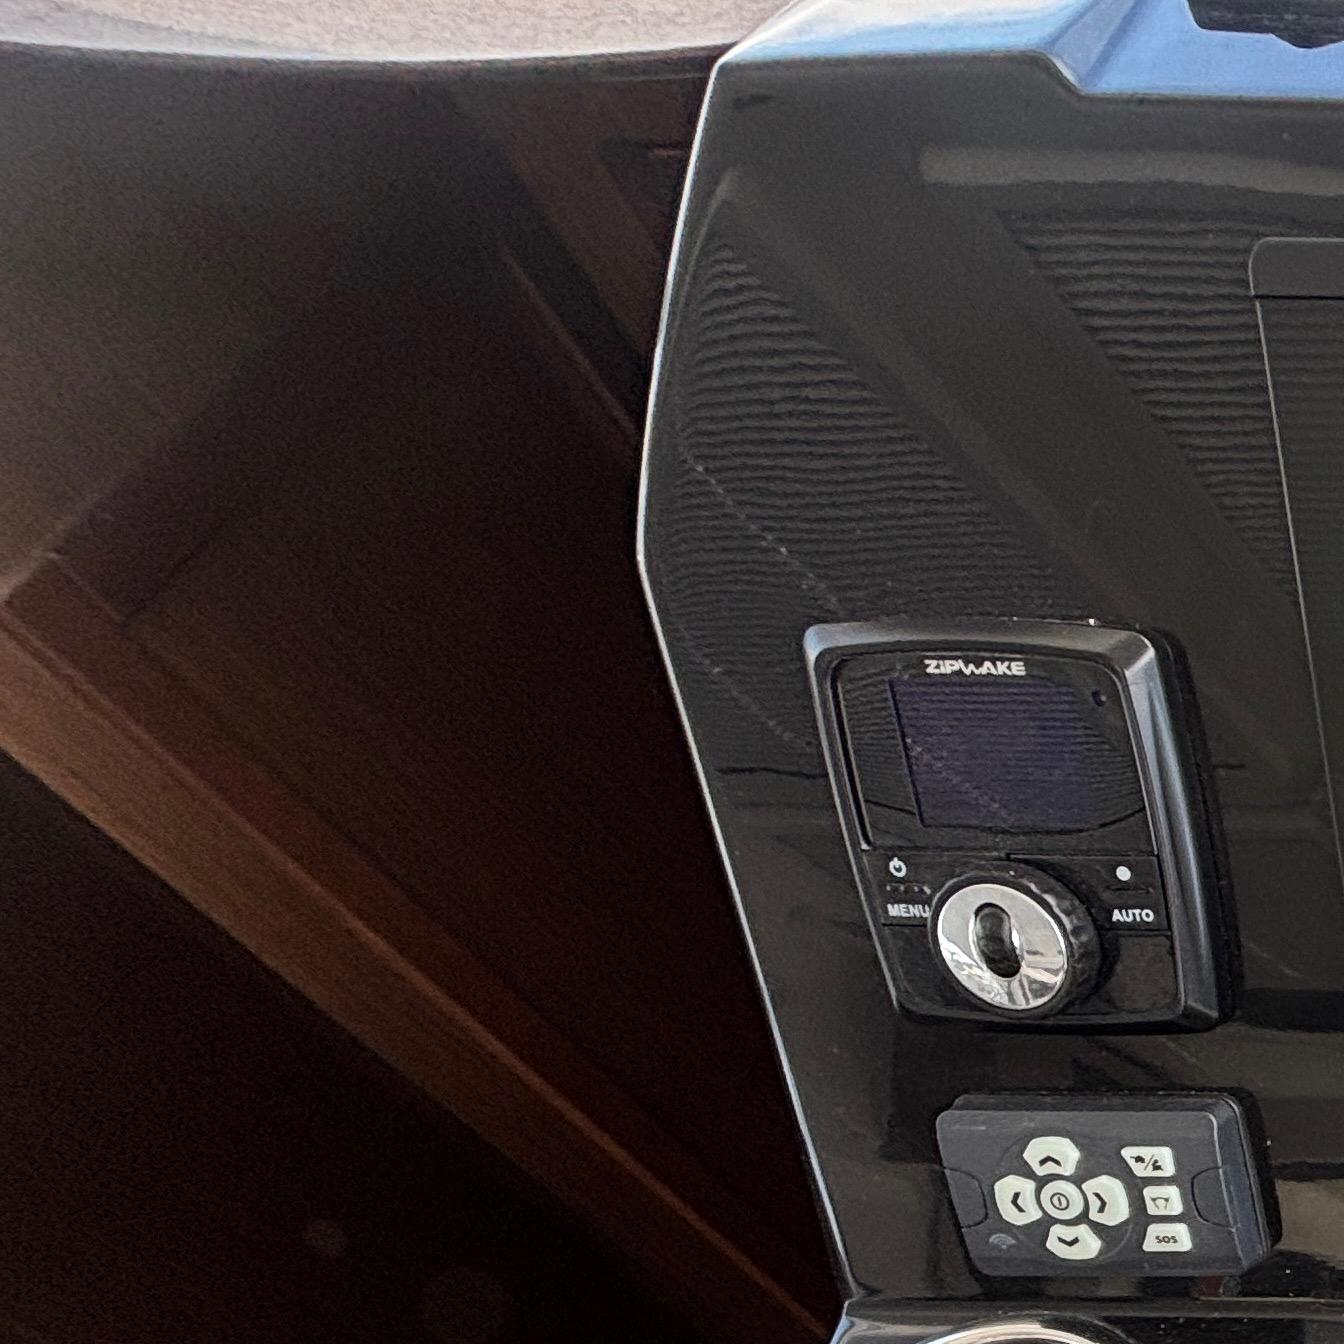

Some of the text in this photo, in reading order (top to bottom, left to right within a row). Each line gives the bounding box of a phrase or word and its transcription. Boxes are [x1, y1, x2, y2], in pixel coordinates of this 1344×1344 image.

[923, 659, 1026, 676] ZIPWAKE
[886, 903, 930, 919] MENU
[1111, 907, 1154, 924] AUTO
[1155, 1235, 1178, 1244] SOS
